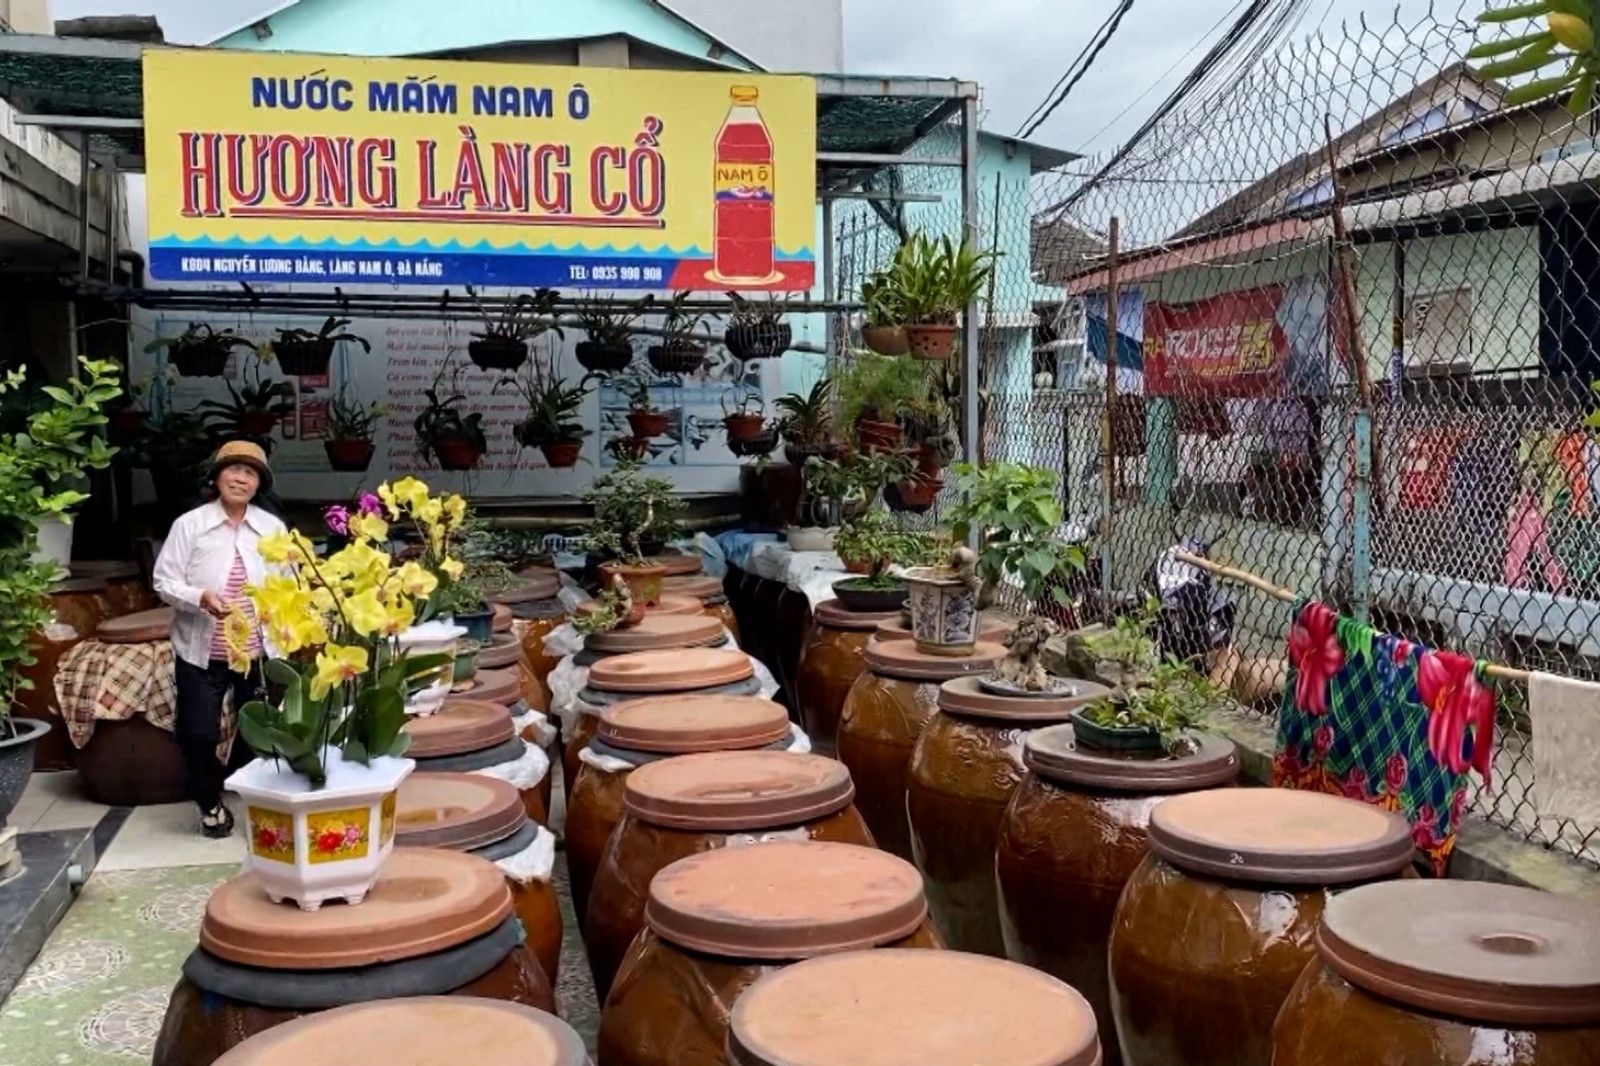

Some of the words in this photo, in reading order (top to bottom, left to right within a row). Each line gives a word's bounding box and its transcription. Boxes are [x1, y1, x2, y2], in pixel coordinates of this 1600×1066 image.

[252, 69, 353, 111] NƯỚC
[473, 85, 553, 118] NAM
[568, 83, 589, 120] Ô
[179, 132, 397, 218] HƯƠNG
[416, 124, 572, 213] LÀNG
[590, 116, 666, 216] CỔ
[717, 168, 753, 182] NAM
[359, 260, 382, 275] NAM
